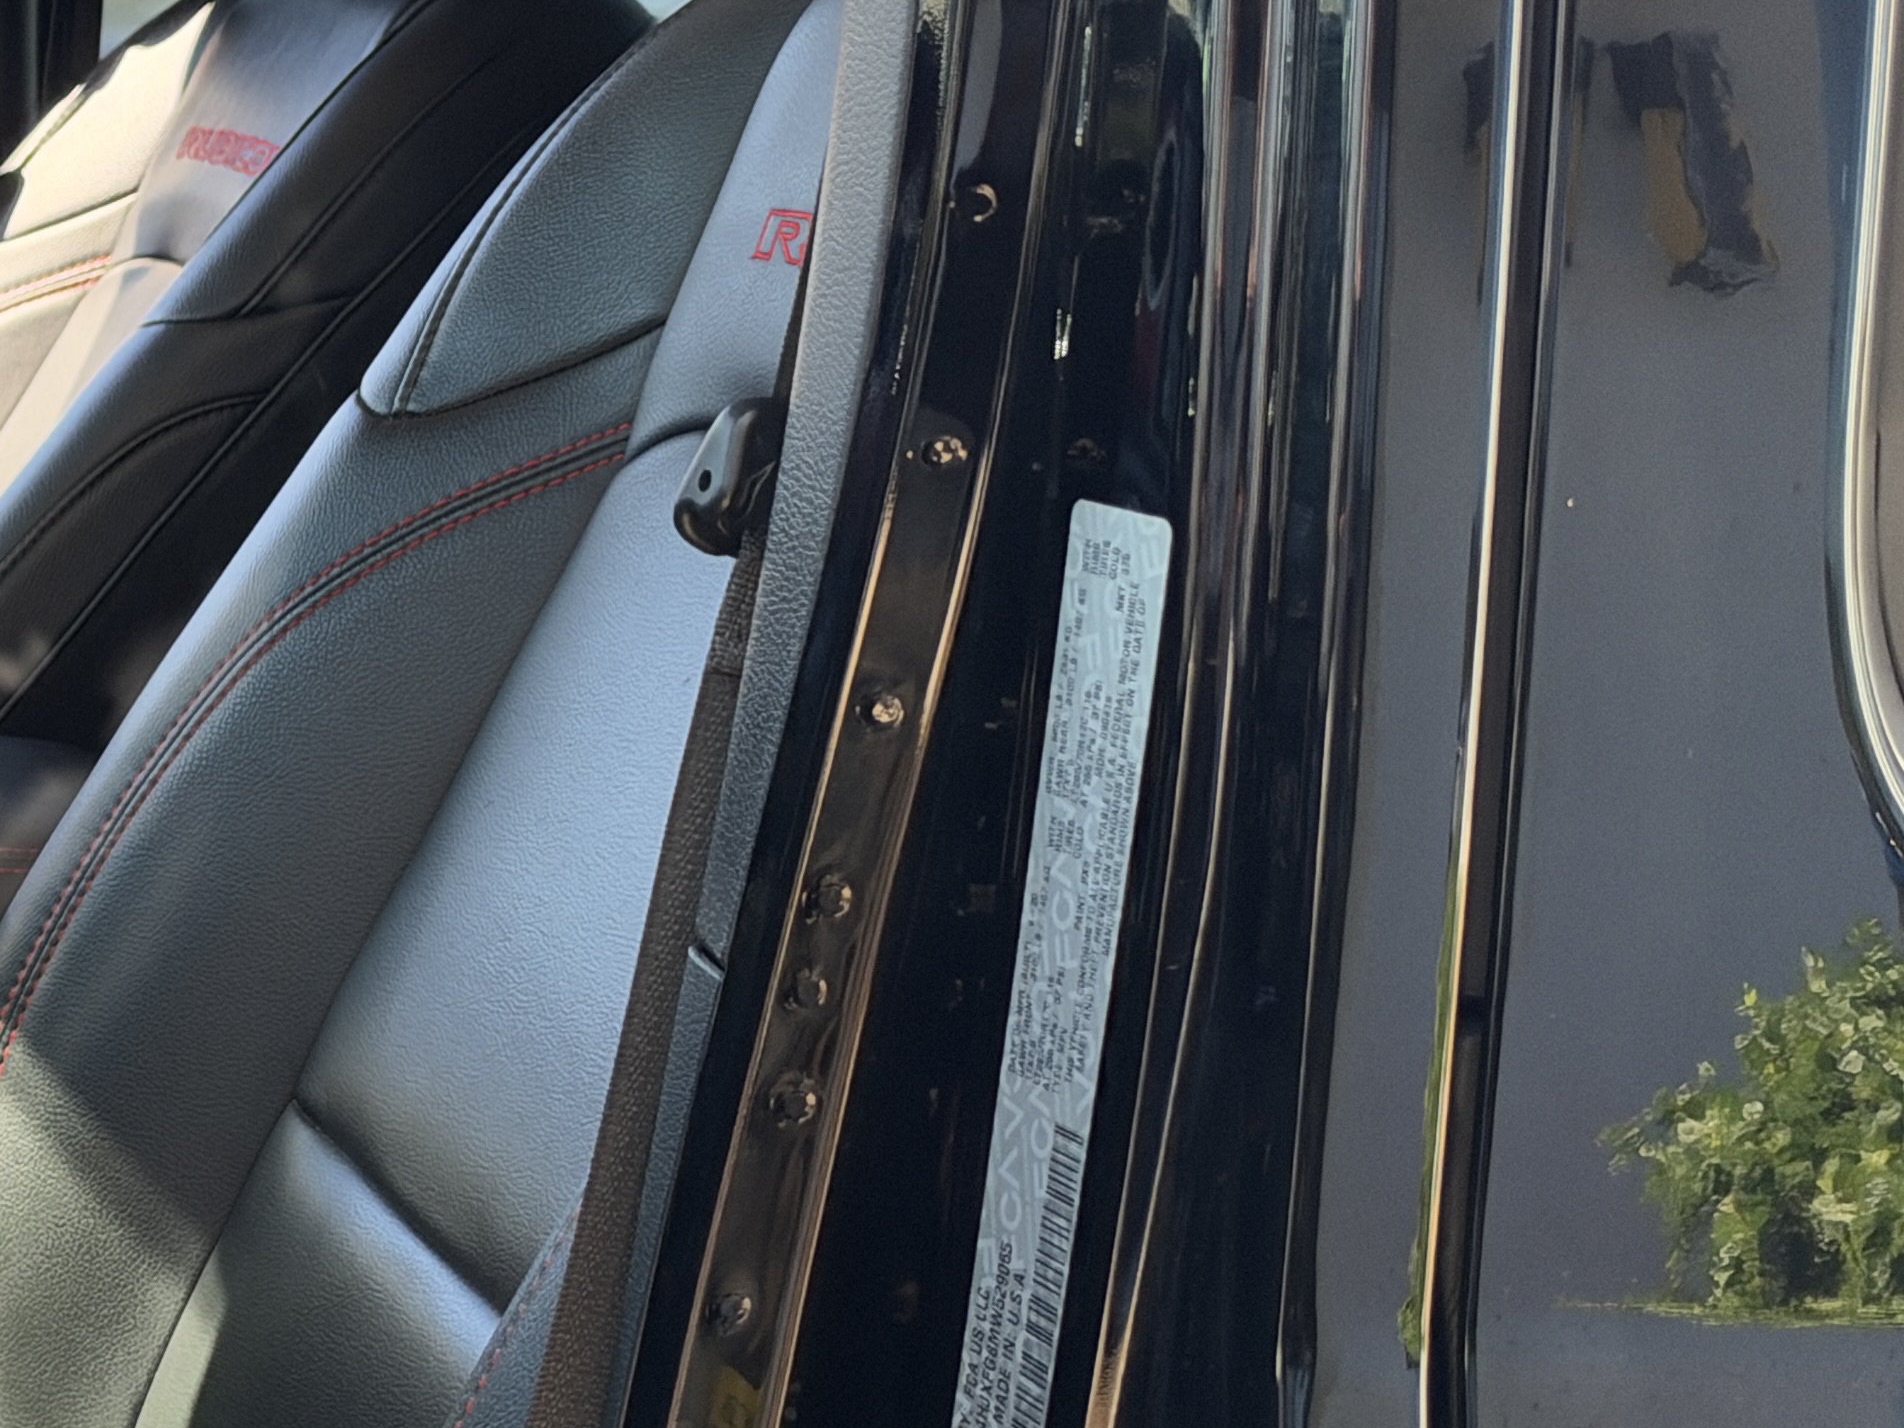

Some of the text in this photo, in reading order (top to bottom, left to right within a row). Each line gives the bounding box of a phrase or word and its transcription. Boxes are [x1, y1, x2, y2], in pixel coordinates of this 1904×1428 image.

[1123, 580, 1140, 635] VEHICLE
[1092, 862, 1112, 945] PREVENTION
[973, 1284, 991, 1324] LLC
[968, 1324, 985, 1358] US
[962, 1358, 980, 1401] FCA
[991, 1364, 1011, 1426] MADE
